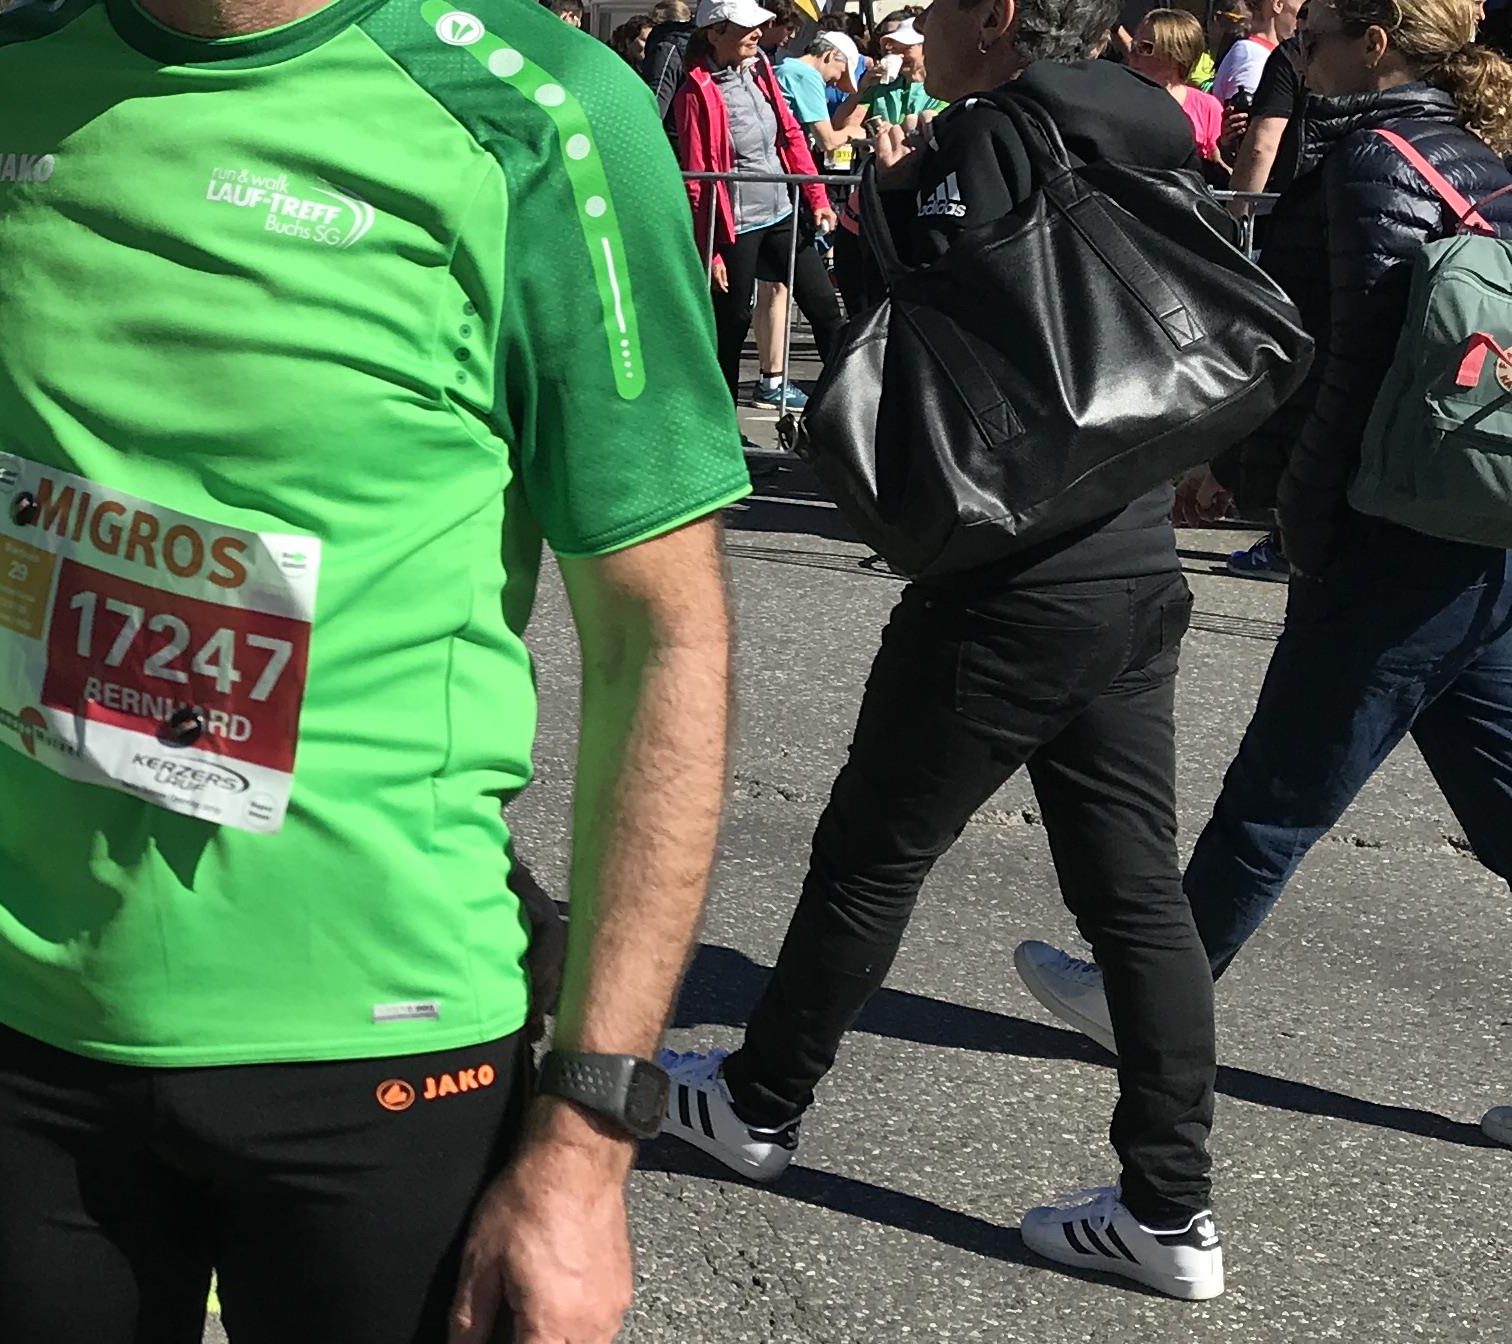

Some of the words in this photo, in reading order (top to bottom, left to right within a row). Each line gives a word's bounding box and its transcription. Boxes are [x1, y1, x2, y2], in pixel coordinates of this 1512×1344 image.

[212, 167, 236, 180] run
[251, 173, 289, 193] walk
[206, 180, 342, 224] LAUF-TREFF
[264, 214, 311, 239] Buchs
[312, 225, 340, 246] SG
[30, 477, 247, 589] MIGROS
[69, 590, 294, 703] 17247
[132, 753, 239, 792] KERZERS
[423, 1063, 496, 1099] JAKO
